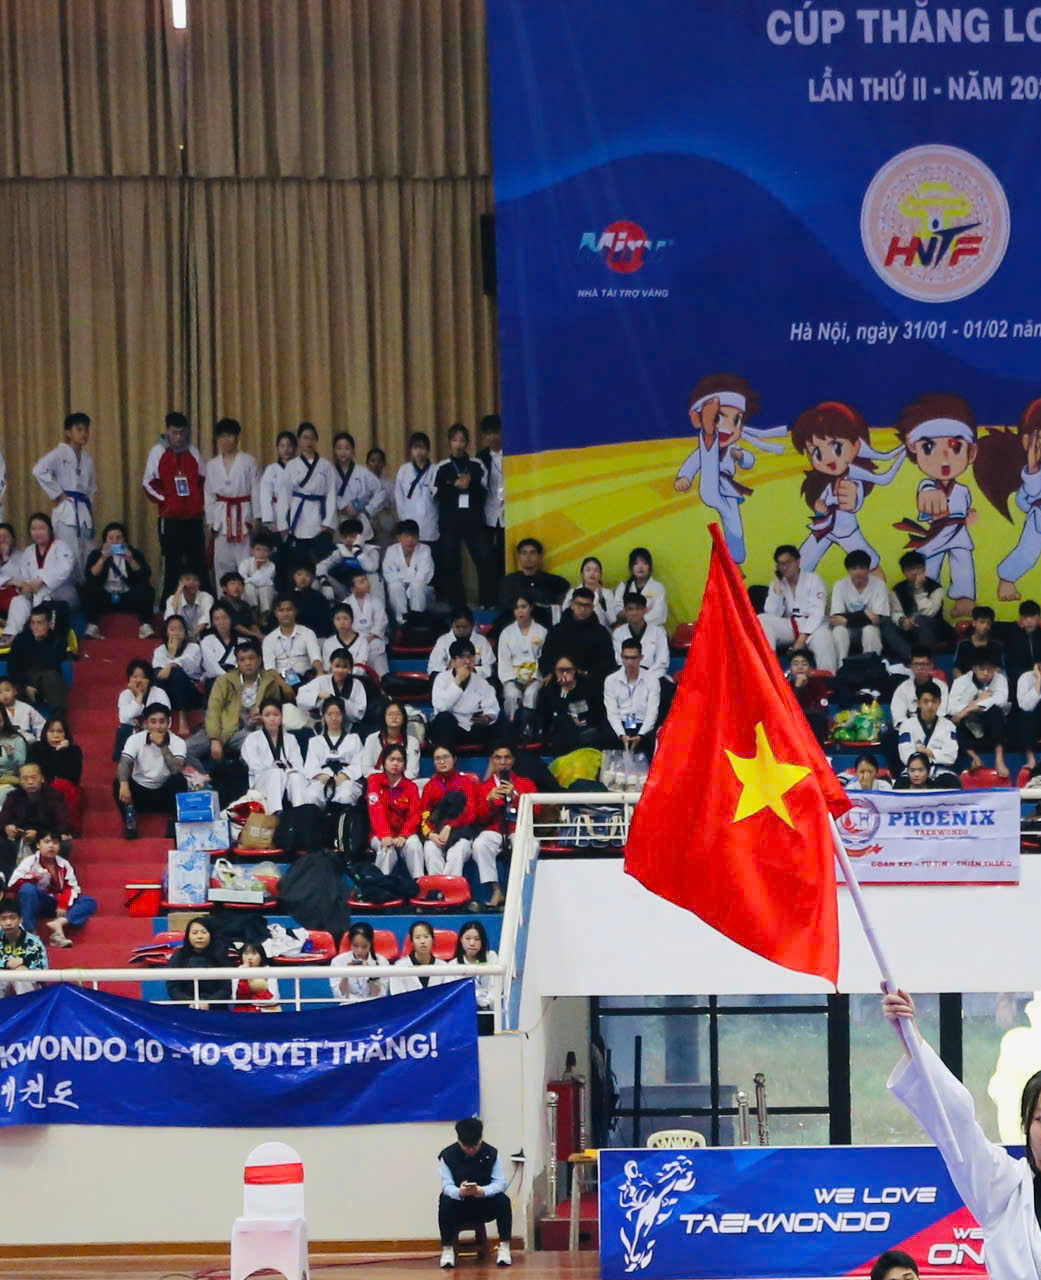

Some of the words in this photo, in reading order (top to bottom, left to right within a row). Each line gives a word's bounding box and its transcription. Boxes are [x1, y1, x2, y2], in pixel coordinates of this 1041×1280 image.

[766, 1, 845, 46] CÚP
[808, 65, 853, 102] LẦN
[860, 70, 907, 101] THỨ
[913, 77, 928, 101] II
[933, 87, 942, 95] -
[948, 70, 1003, 101] NĂM
[577, 287, 599, 298] NHÀ
[790, 322, 813, 341] Hà
[818, 321, 850, 344] Nội,
[856, 321, 899, 345] ngày
[903, 320, 947, 340] 31/01
[963, 319, 1008, 339] 01/02
[888, 809, 996, 827] PHOENIX
[134, 1037, 164, 1063] 10
[190, 1042, 221, 1067] 10
[331, 1028, 438, 1065] THẮNG!
[814, 1186, 856, 1204] WE
[862, 1186, 938, 1204] LOVE
[679, 1210, 891, 1234] TAEKWONDO
[953, 1227, 985, 1240] WE
